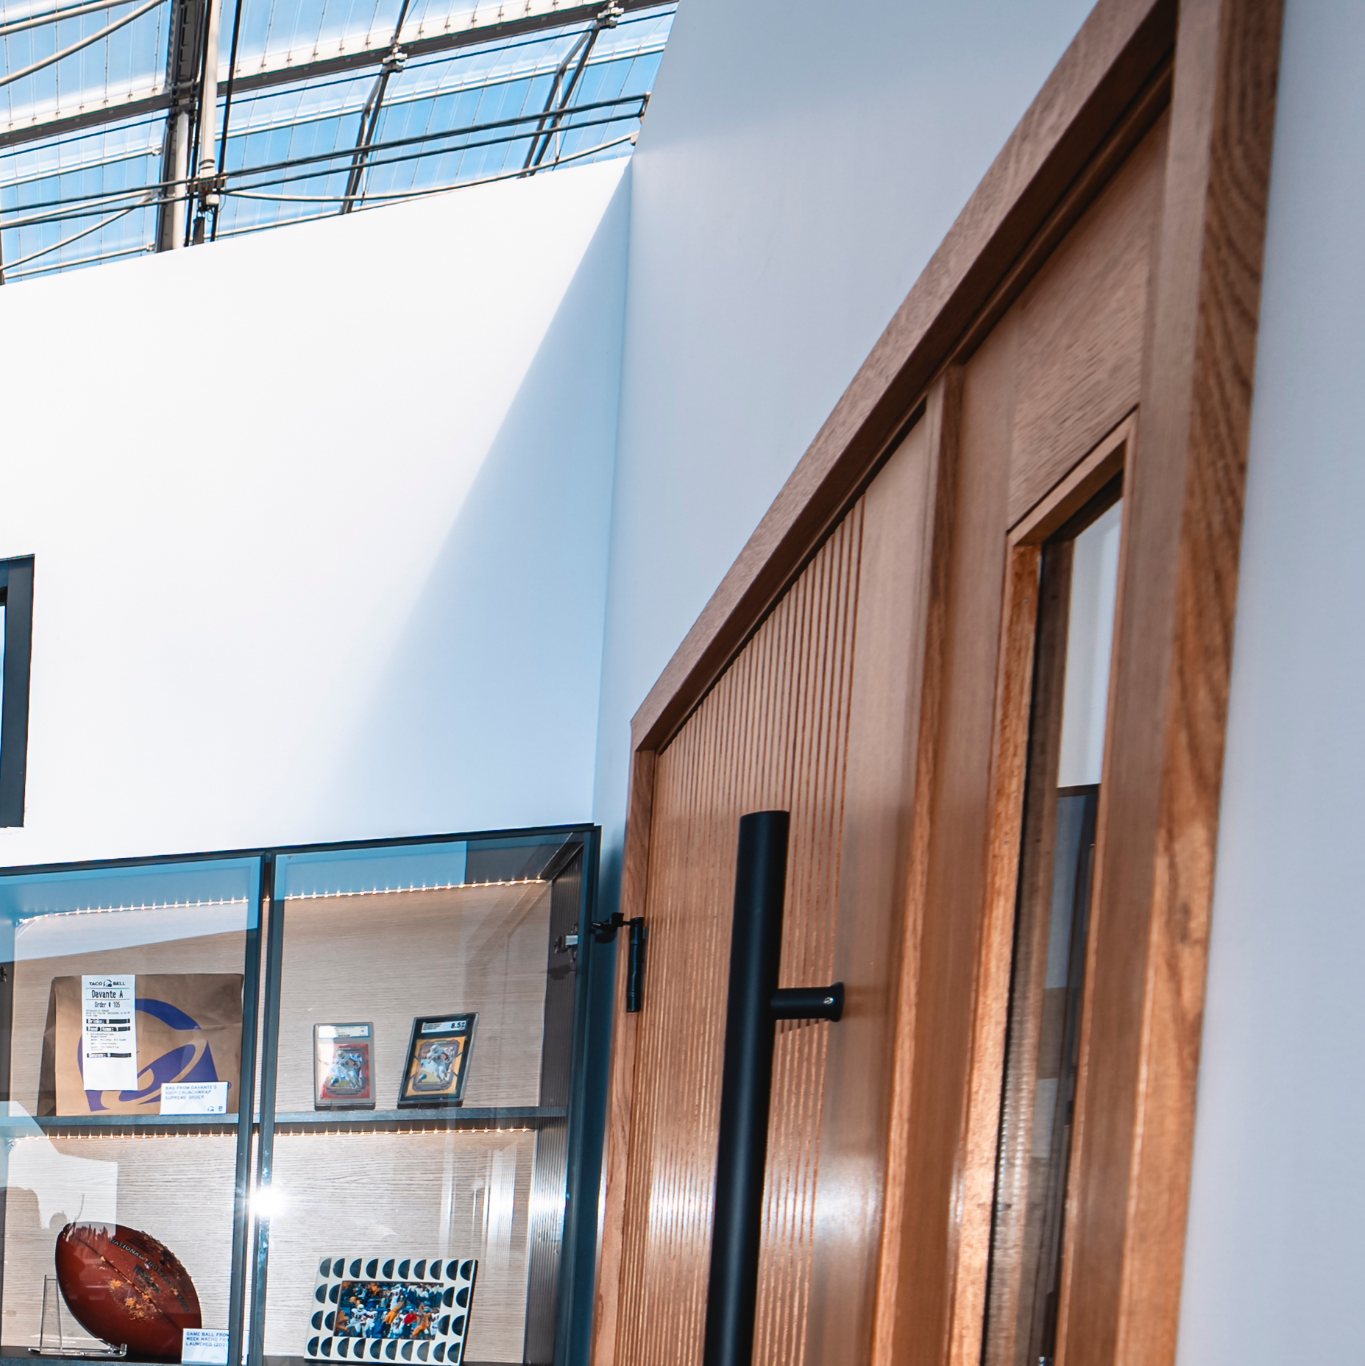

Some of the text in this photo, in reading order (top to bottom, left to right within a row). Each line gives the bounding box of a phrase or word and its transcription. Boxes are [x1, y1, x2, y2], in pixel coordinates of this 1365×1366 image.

[91, 989, 123, 998] Davante A
[110, 1238, 144, 1259] NATIONAL
